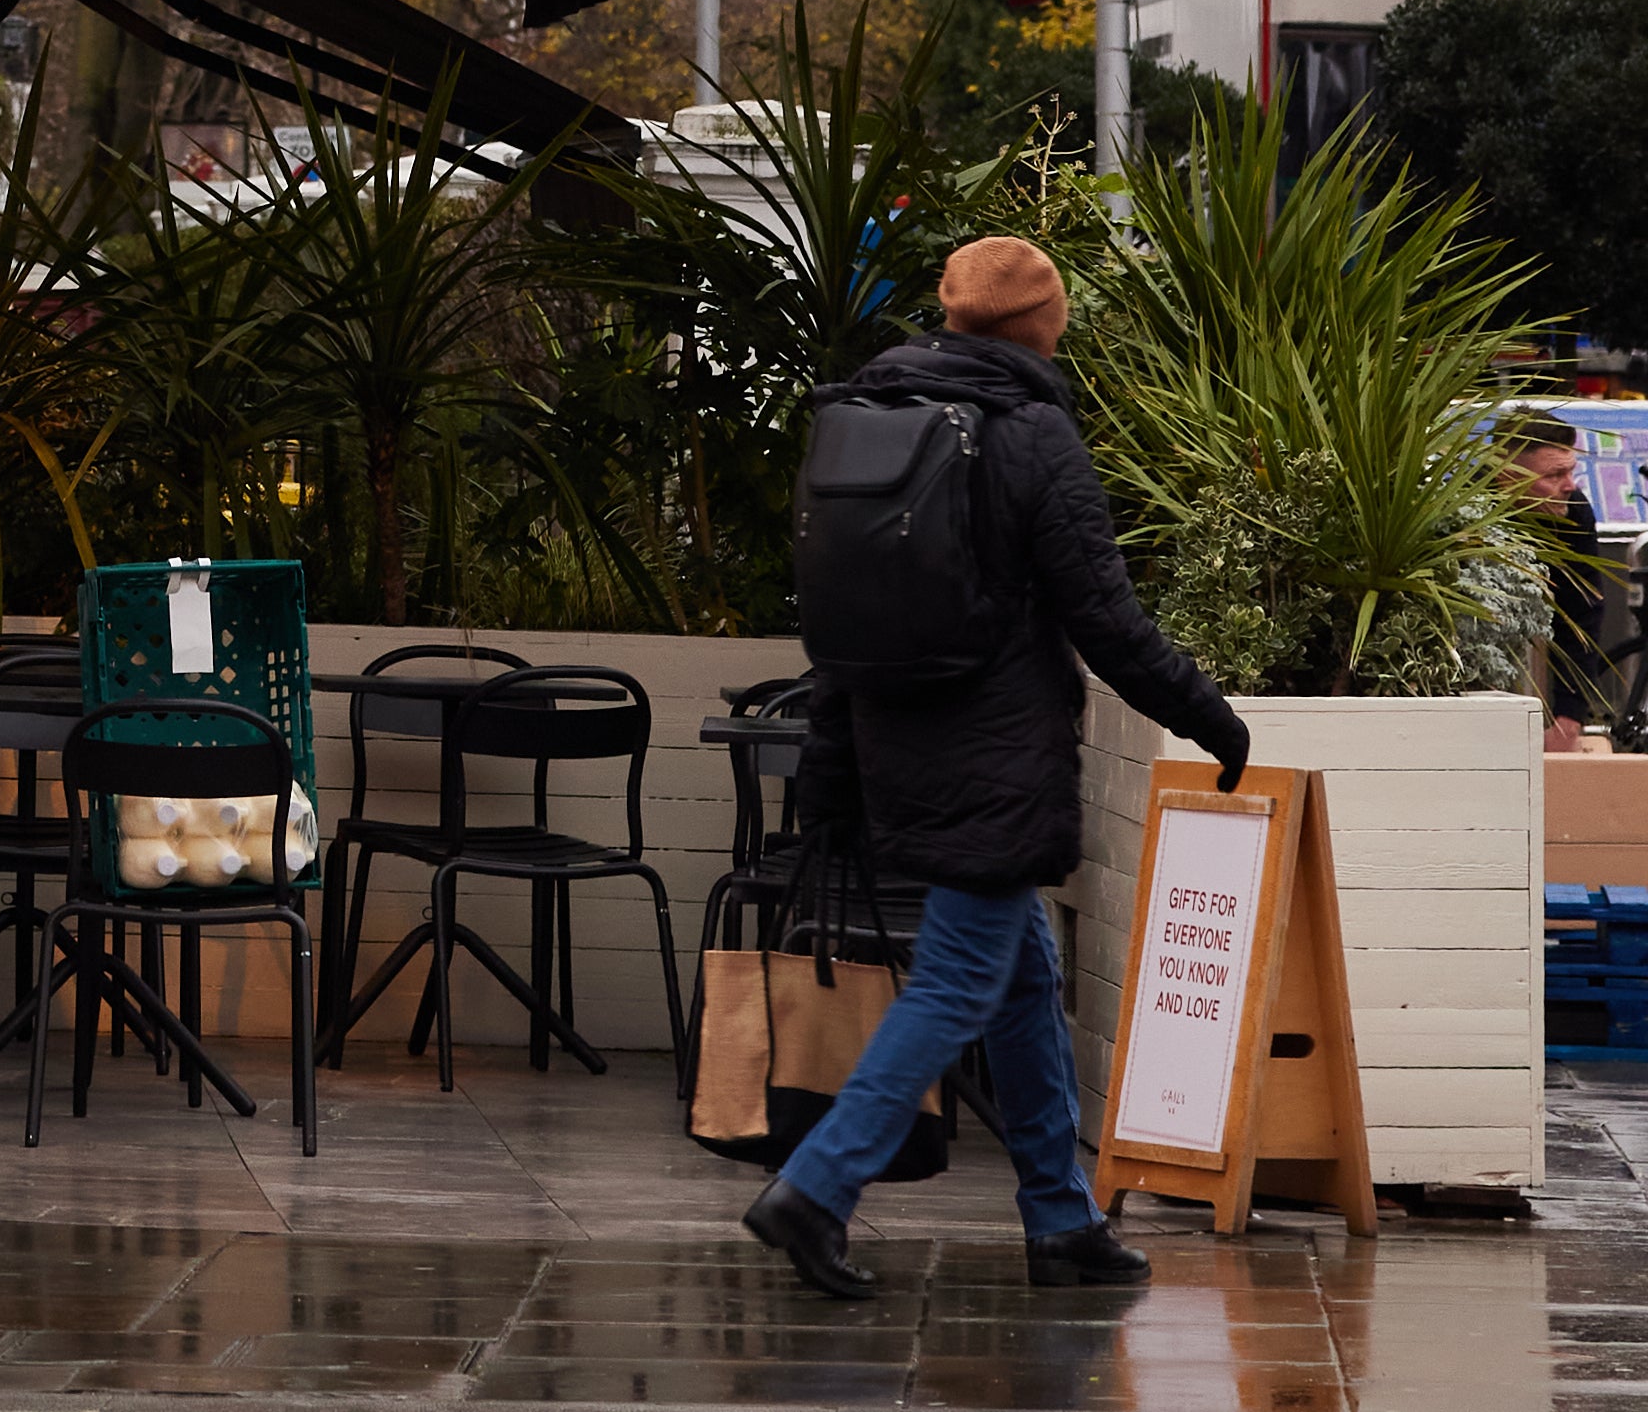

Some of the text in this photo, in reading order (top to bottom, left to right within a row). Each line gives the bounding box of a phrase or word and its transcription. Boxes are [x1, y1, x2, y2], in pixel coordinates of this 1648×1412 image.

[1169, 887, 1238, 918] GIFTS FOR
[1164, 921, 1232, 952] EVERYONE
[1159, 956, 1229, 987] YOU KNOW
[1155, 991, 1221, 1022] AND LOVE
